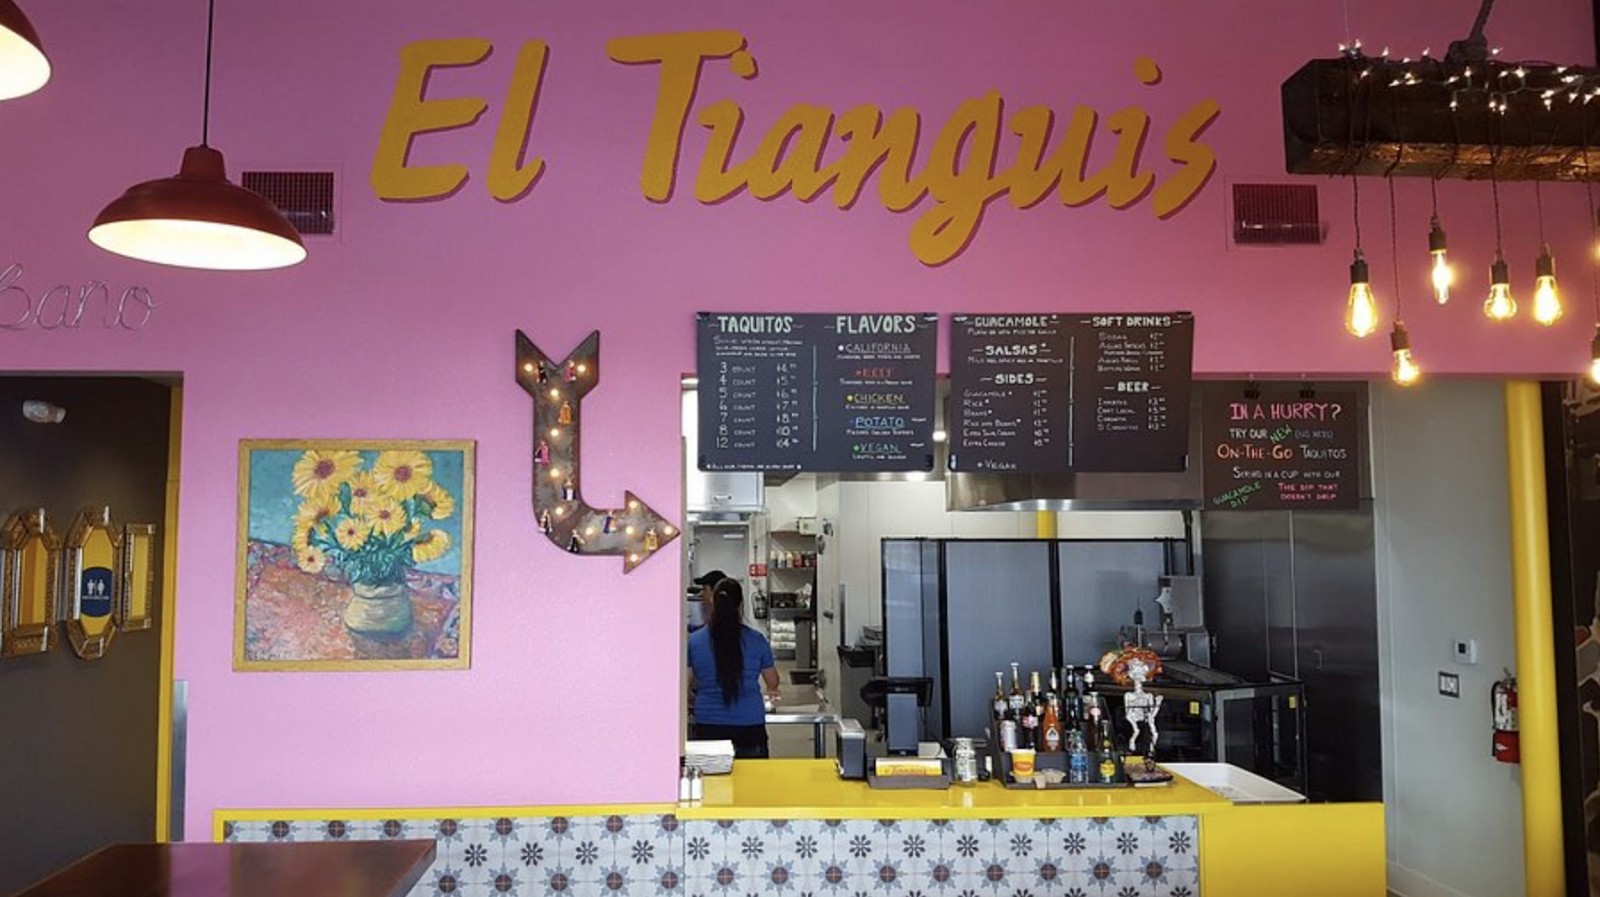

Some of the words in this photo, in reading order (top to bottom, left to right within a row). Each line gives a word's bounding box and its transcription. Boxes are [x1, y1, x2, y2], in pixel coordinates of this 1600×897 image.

[370, 37, 549, 203] El
[606, 30, 1221, 267] Tianguis
[717, 316, 793, 333] TAQUITOS
[836, 315, 916, 334] FLAVORS
[974, 316, 1049, 328] GUACAMOLE
[1092, 316, 1123, 327] SOFT
[1126, 316, 1171, 327] DRINKS
[845, 343, 911, 353] CALIFORNIA
[985, 345, 1038, 356] SALSAS
[720, 362, 727, 373] 3
[719, 375, 727, 385] 4
[994, 374, 1034, 385] SIDES
[1117, 381, 1149, 392] BEER
[719, 387, 727, 398] 5
[854, 394, 905, 404] CHICKEN
[719, 400, 727, 410] 6
[720, 412, 728, 422] 7
[1230, 403, 1248, 420] IN
[1253, 404, 1265, 419] A
[1271, 402, 1341, 421] HURRY?
[855, 416, 904, 428] POTATO
[719, 424, 728, 435] 8
[1229, 428, 1246, 439] TRY
[1250, 428, 1268, 439] OUR
[1270, 424, 1292, 443] NEW
[716, 437, 728, 448] 12
[860, 443, 902, 453] VEGAN
